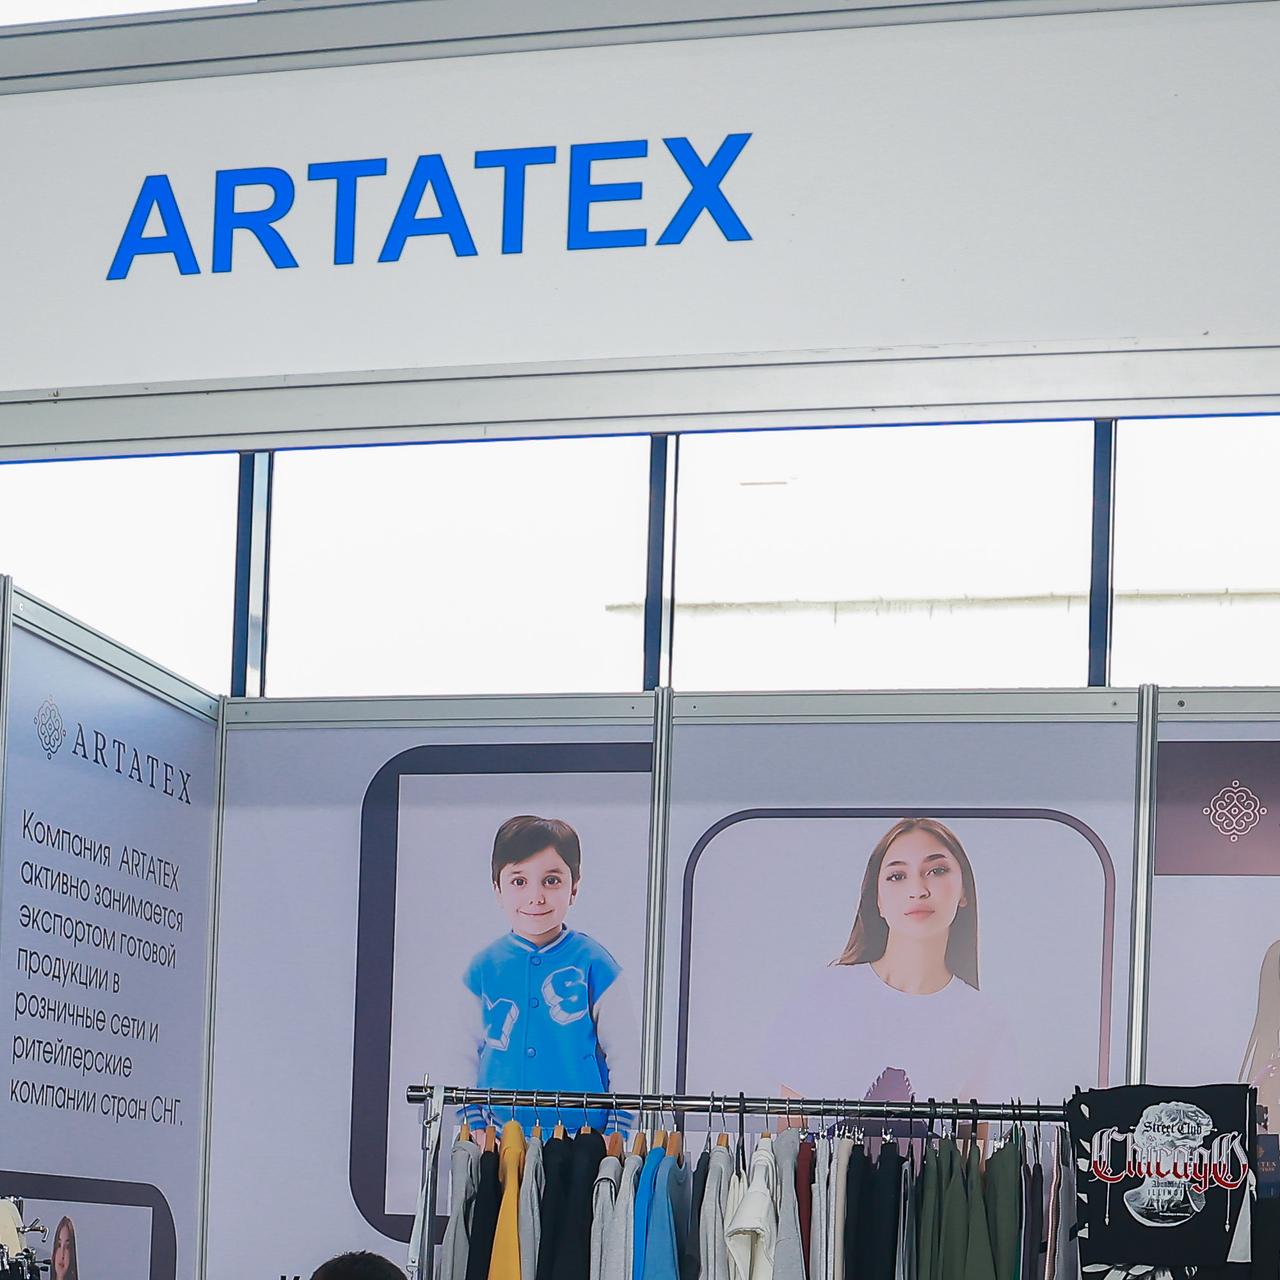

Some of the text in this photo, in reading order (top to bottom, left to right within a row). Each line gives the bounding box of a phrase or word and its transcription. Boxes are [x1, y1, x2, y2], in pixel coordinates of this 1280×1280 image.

[105, 133, 753, 281] ARTATEX
[72, 723, 191, 805] ARTATEX
[22, 809, 180, 893] Компания ARTATEX
[21, 861, 184, 932] активно занимается
[19, 905, 177, 969] экспортом готовой
[17, 948, 120, 993] продукции в
[15, 991, 159, 1044] розничные сети и
[12, 1035, 133, 1077] ритейлерские
[10, 1078, 96, 1113] компании
[100, 1093, 147, 1124] стран
